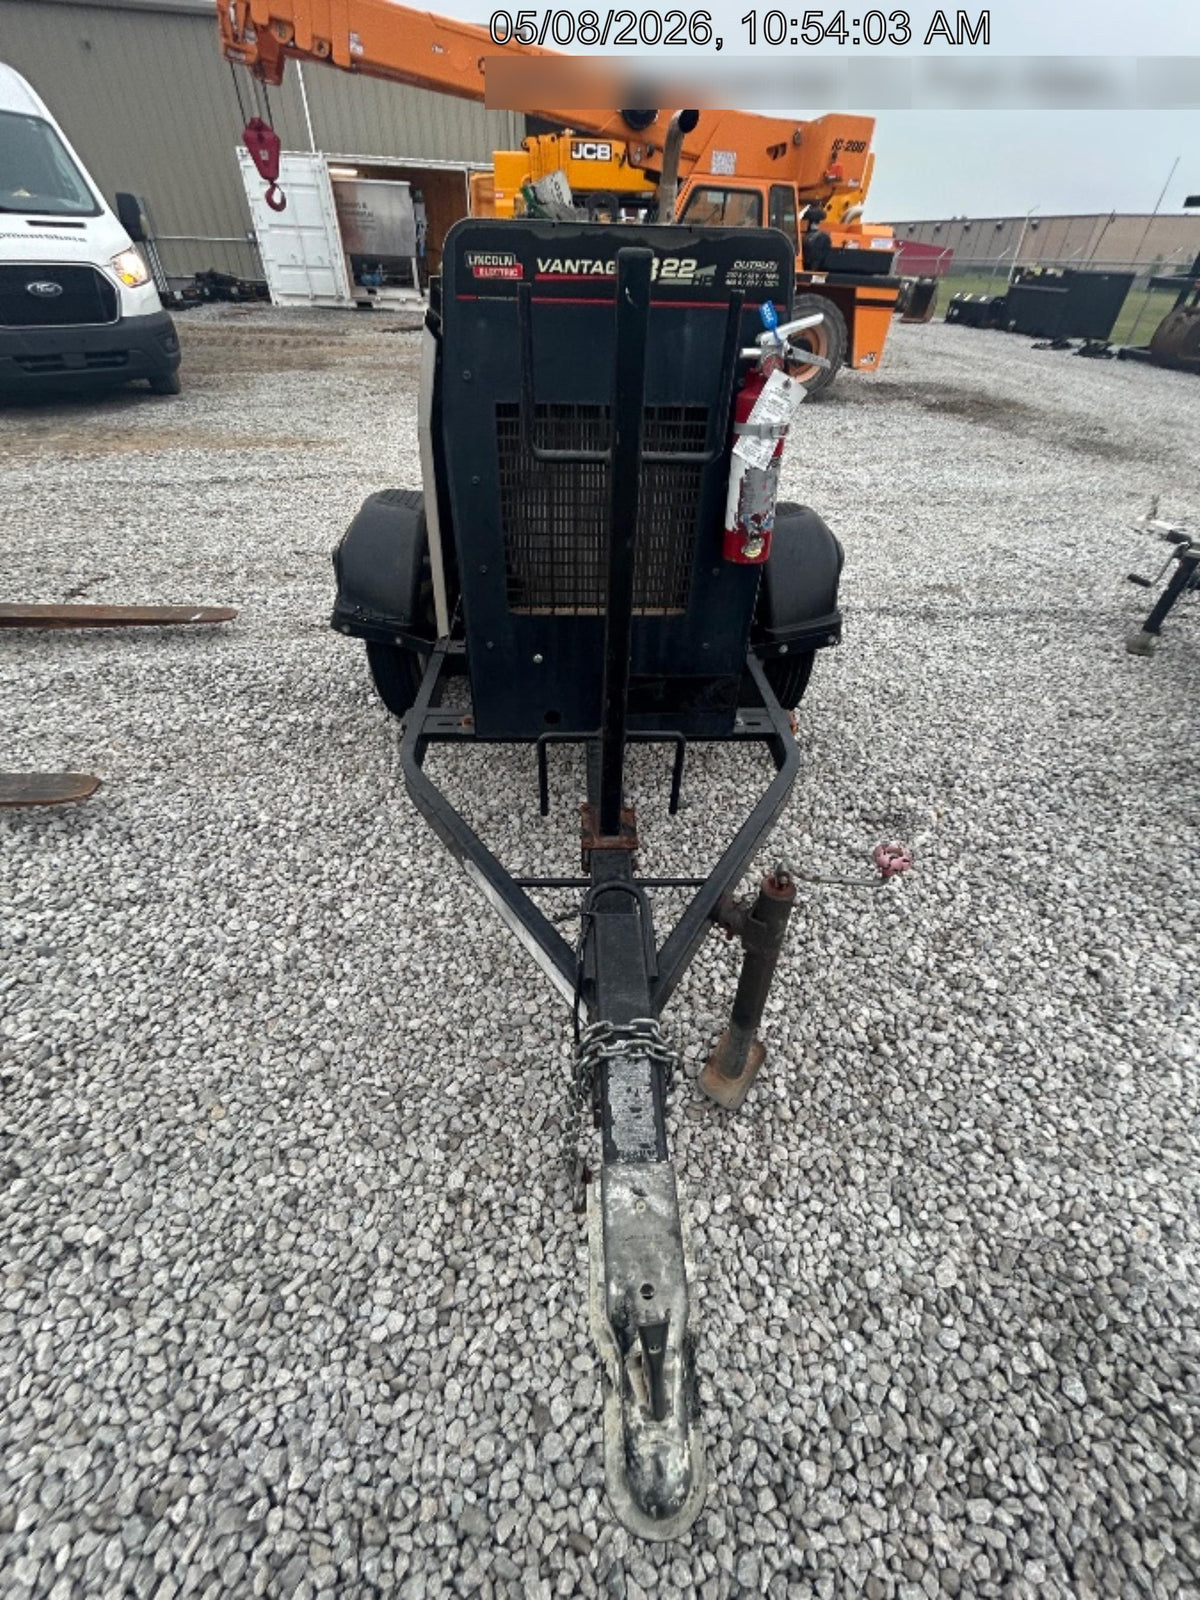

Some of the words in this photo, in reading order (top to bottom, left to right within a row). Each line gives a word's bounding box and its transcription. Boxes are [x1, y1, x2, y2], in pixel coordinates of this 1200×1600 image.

[571, 143, 611, 159] JCB
[832, 139, 866, 153] IC-200
[467, 255, 513, 266] LINCOLN
[536, 258, 617, 274] VANTAG
[479, 267, 518, 277] ELECTRIC
